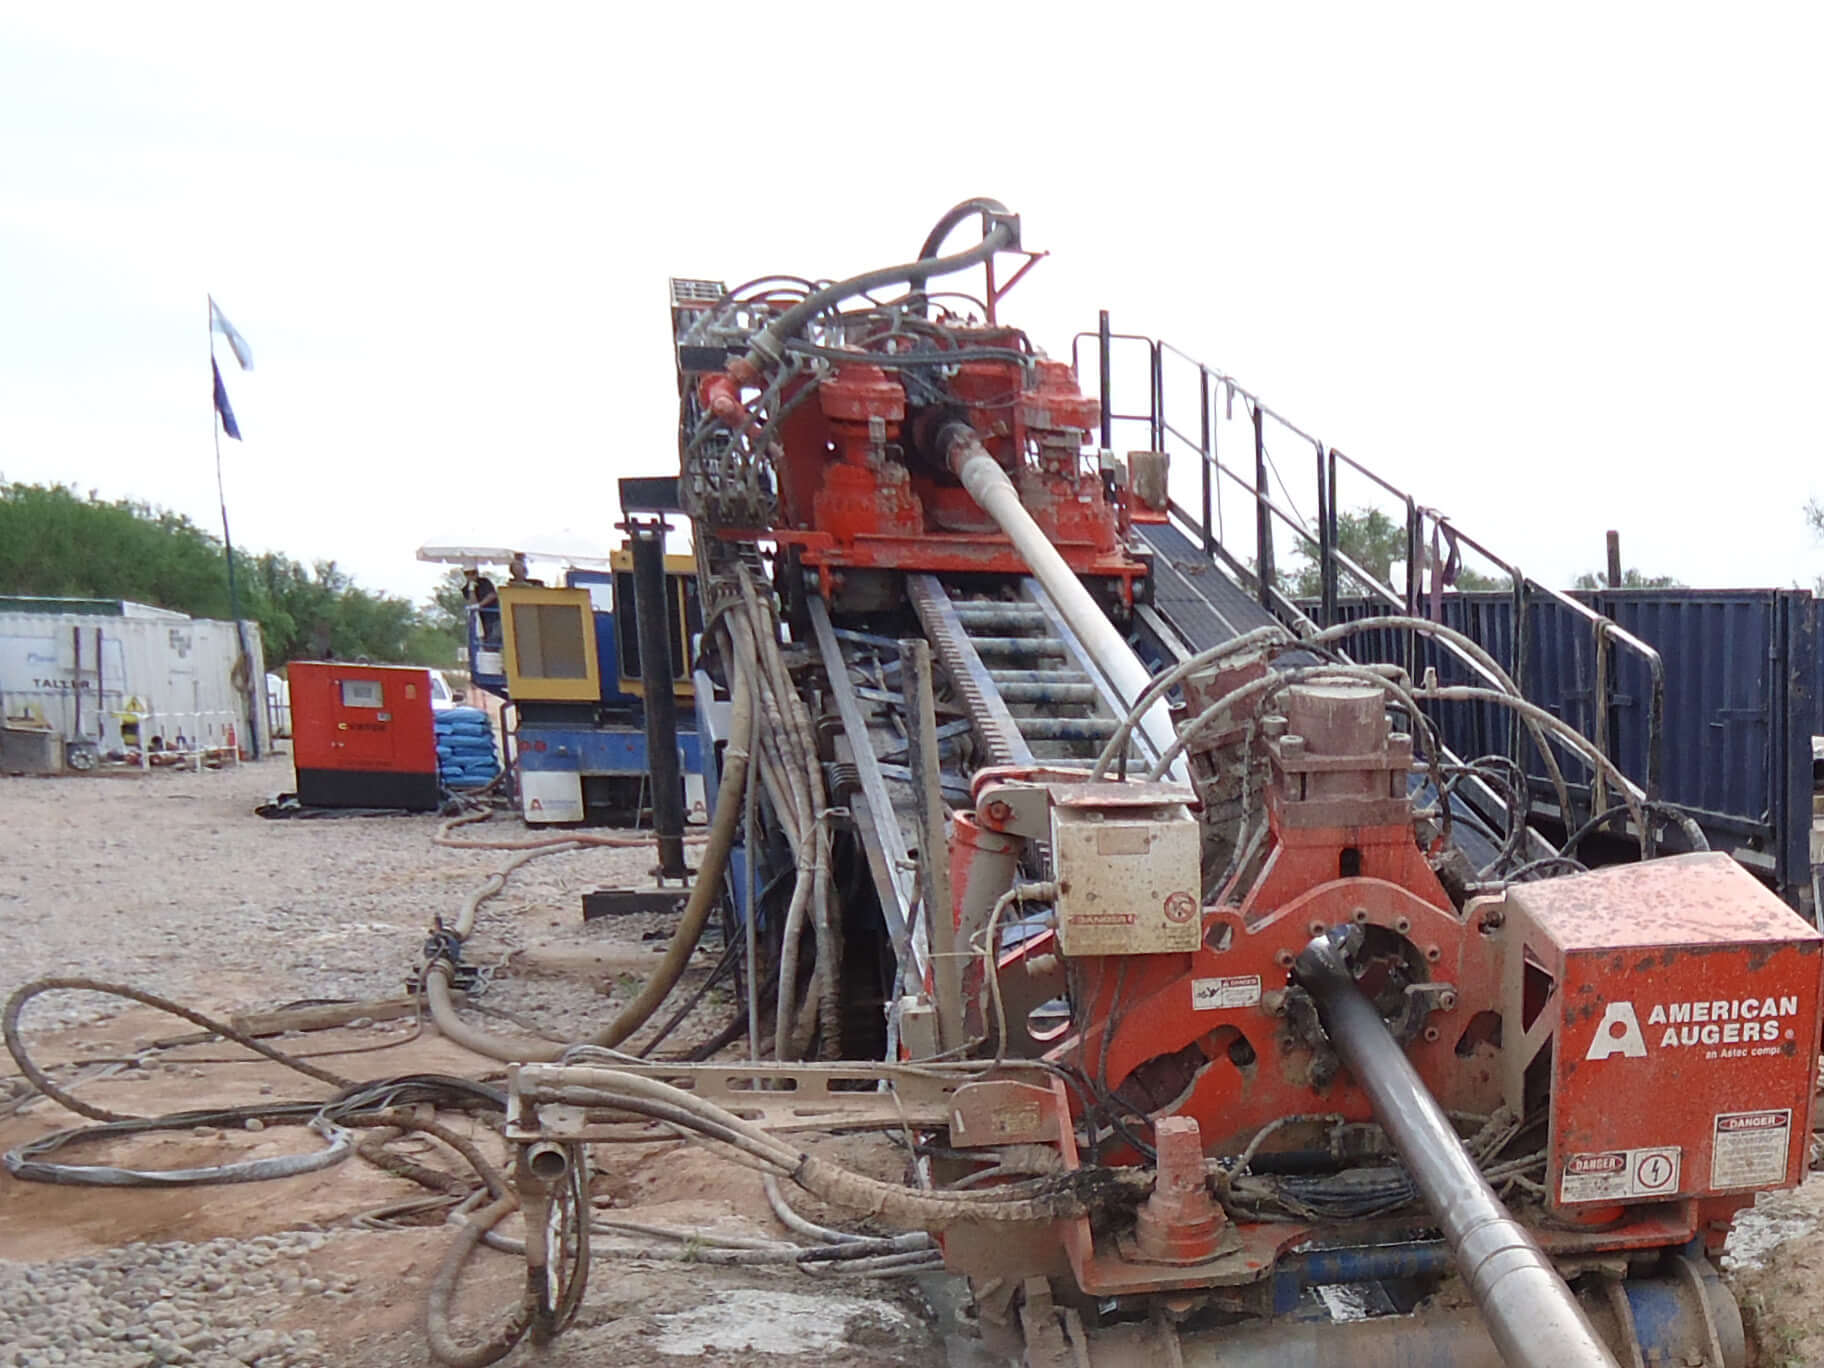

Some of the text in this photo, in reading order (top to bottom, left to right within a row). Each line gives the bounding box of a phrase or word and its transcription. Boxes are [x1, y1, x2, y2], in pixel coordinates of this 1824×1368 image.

[1648, 996, 1798, 1025] AMERICAN
[1660, 1020, 1780, 1047] AUGERS
[1729, 1116, 1776, 1128] DANGER
[1575, 1157, 1617, 1171] DANGER
